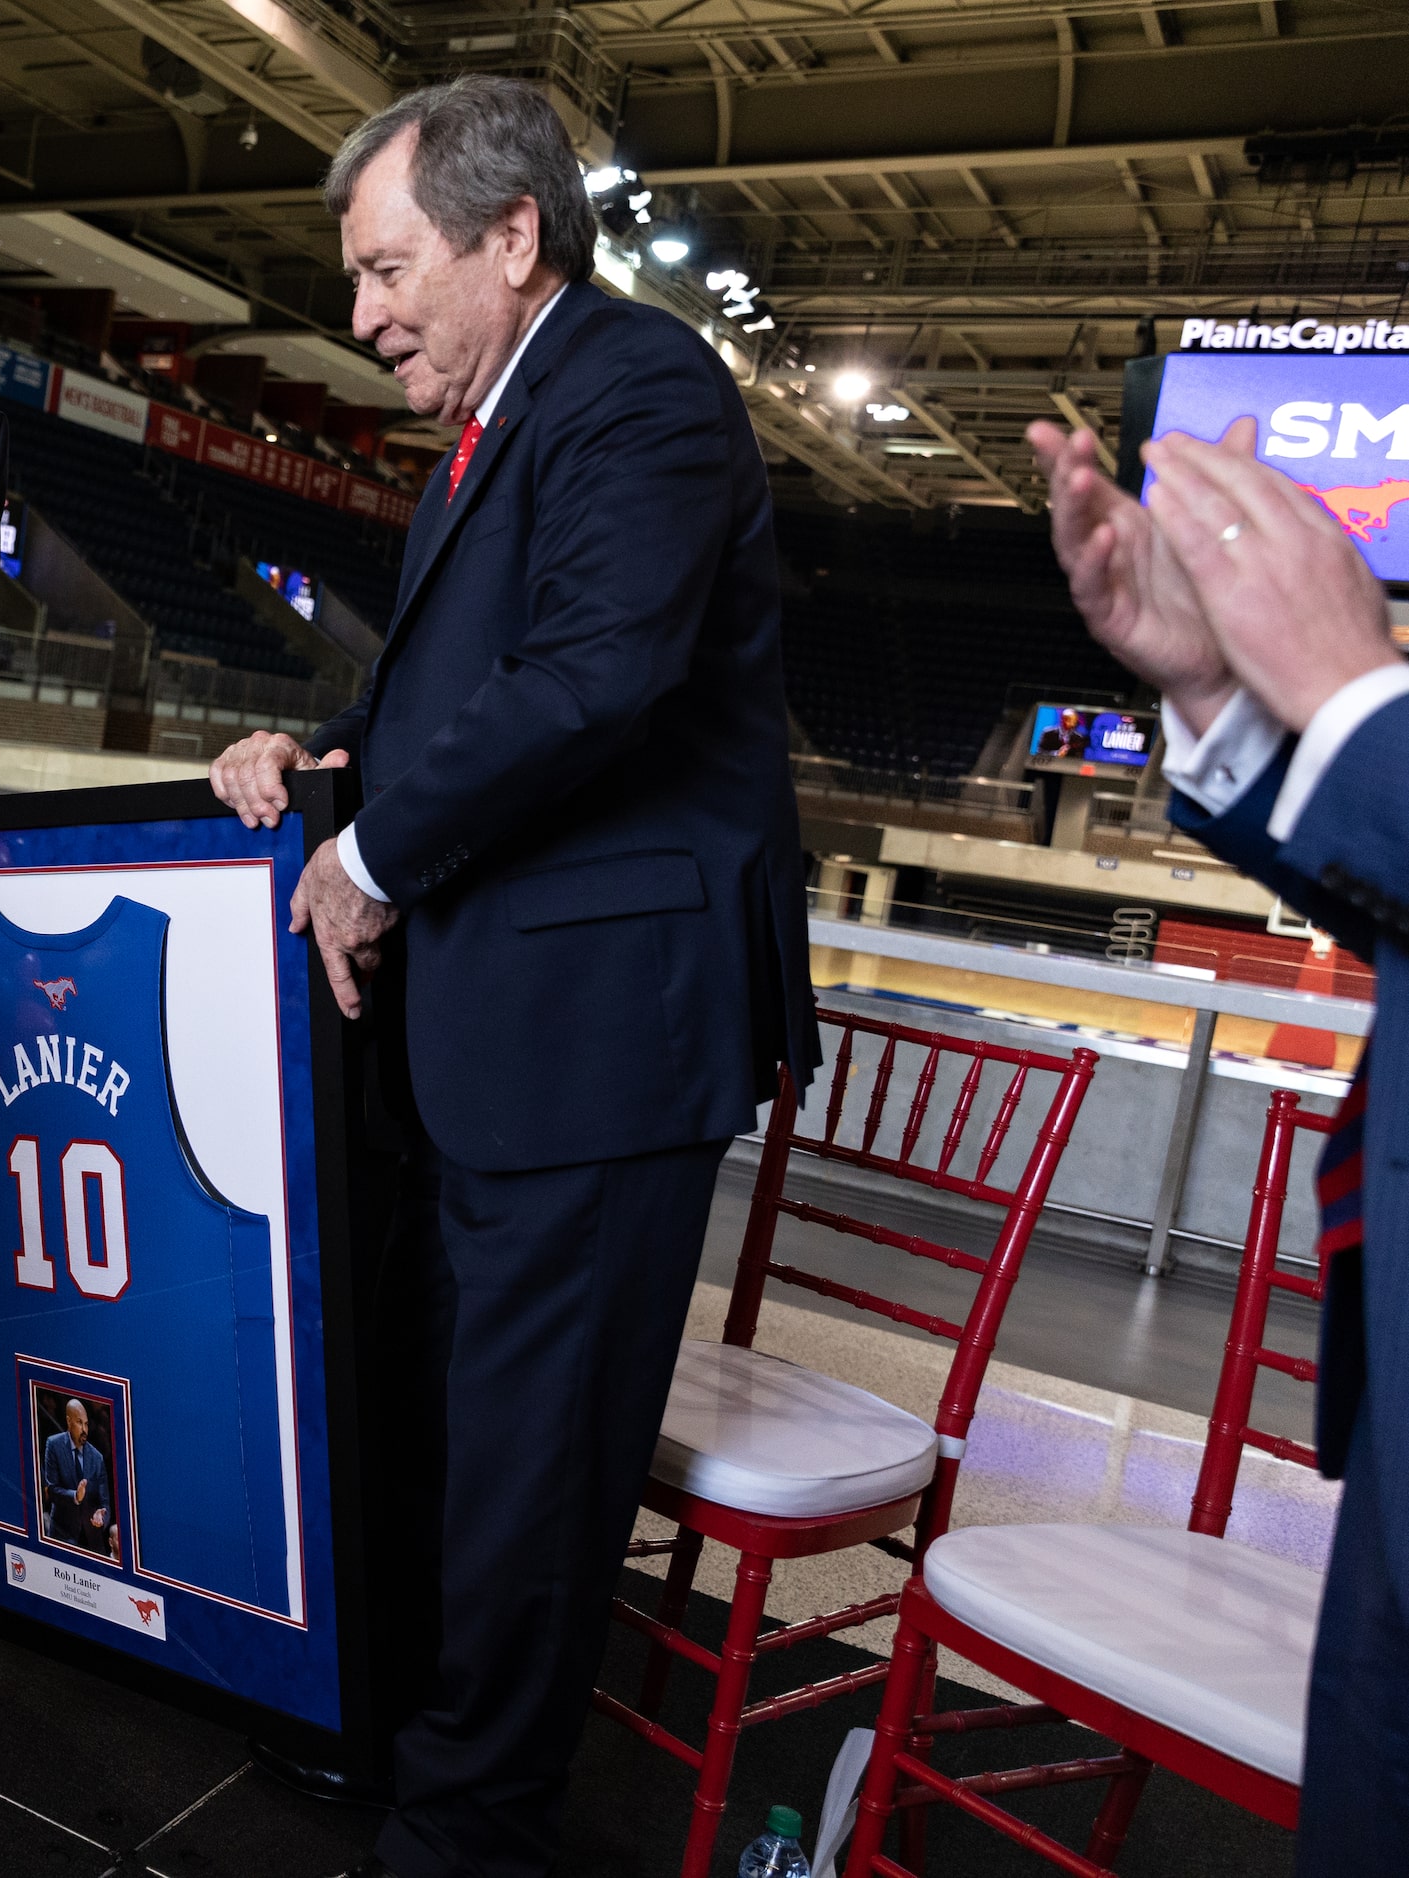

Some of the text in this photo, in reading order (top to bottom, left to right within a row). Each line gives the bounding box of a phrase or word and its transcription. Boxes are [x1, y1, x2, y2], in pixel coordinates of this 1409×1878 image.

[1102, 730, 1145, 752] LANIER
[7, 1134, 132, 1302] 10
[54, 1567, 101, 1592] Rob Lanier
[60, 1591, 73, 1600] SMU
[64, 1584, 91, 1598] Head Coach
